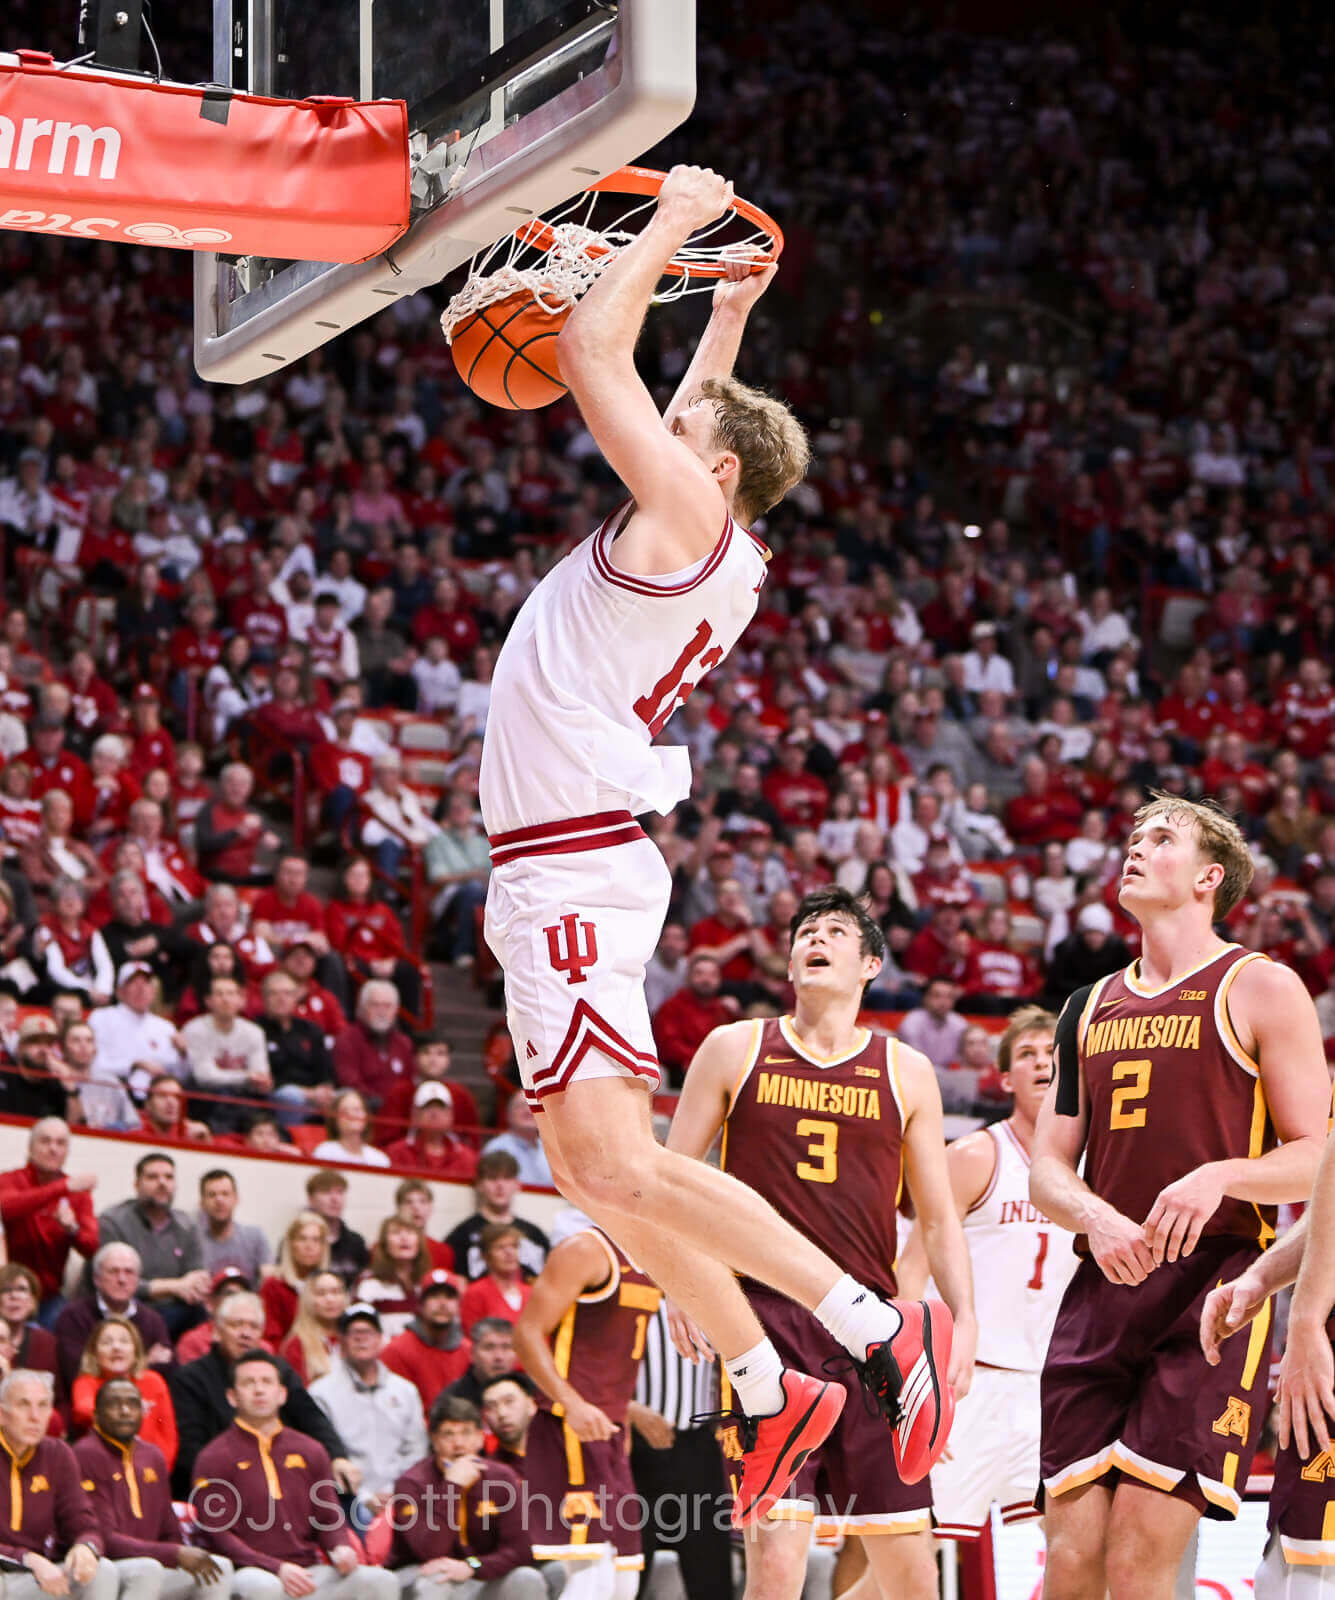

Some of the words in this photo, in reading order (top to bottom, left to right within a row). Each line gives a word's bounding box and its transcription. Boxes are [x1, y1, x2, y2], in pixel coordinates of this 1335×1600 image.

[1086, 1014, 1202, 1059] MINNESOTA
[756, 1072, 881, 1120] MINNESOTA
[1110, 1059, 1152, 1131] 2
[796, 1118, 839, 1184] 3
[1027, 1231, 1049, 1290] 1
[631, 1313, 647, 1360] 1
